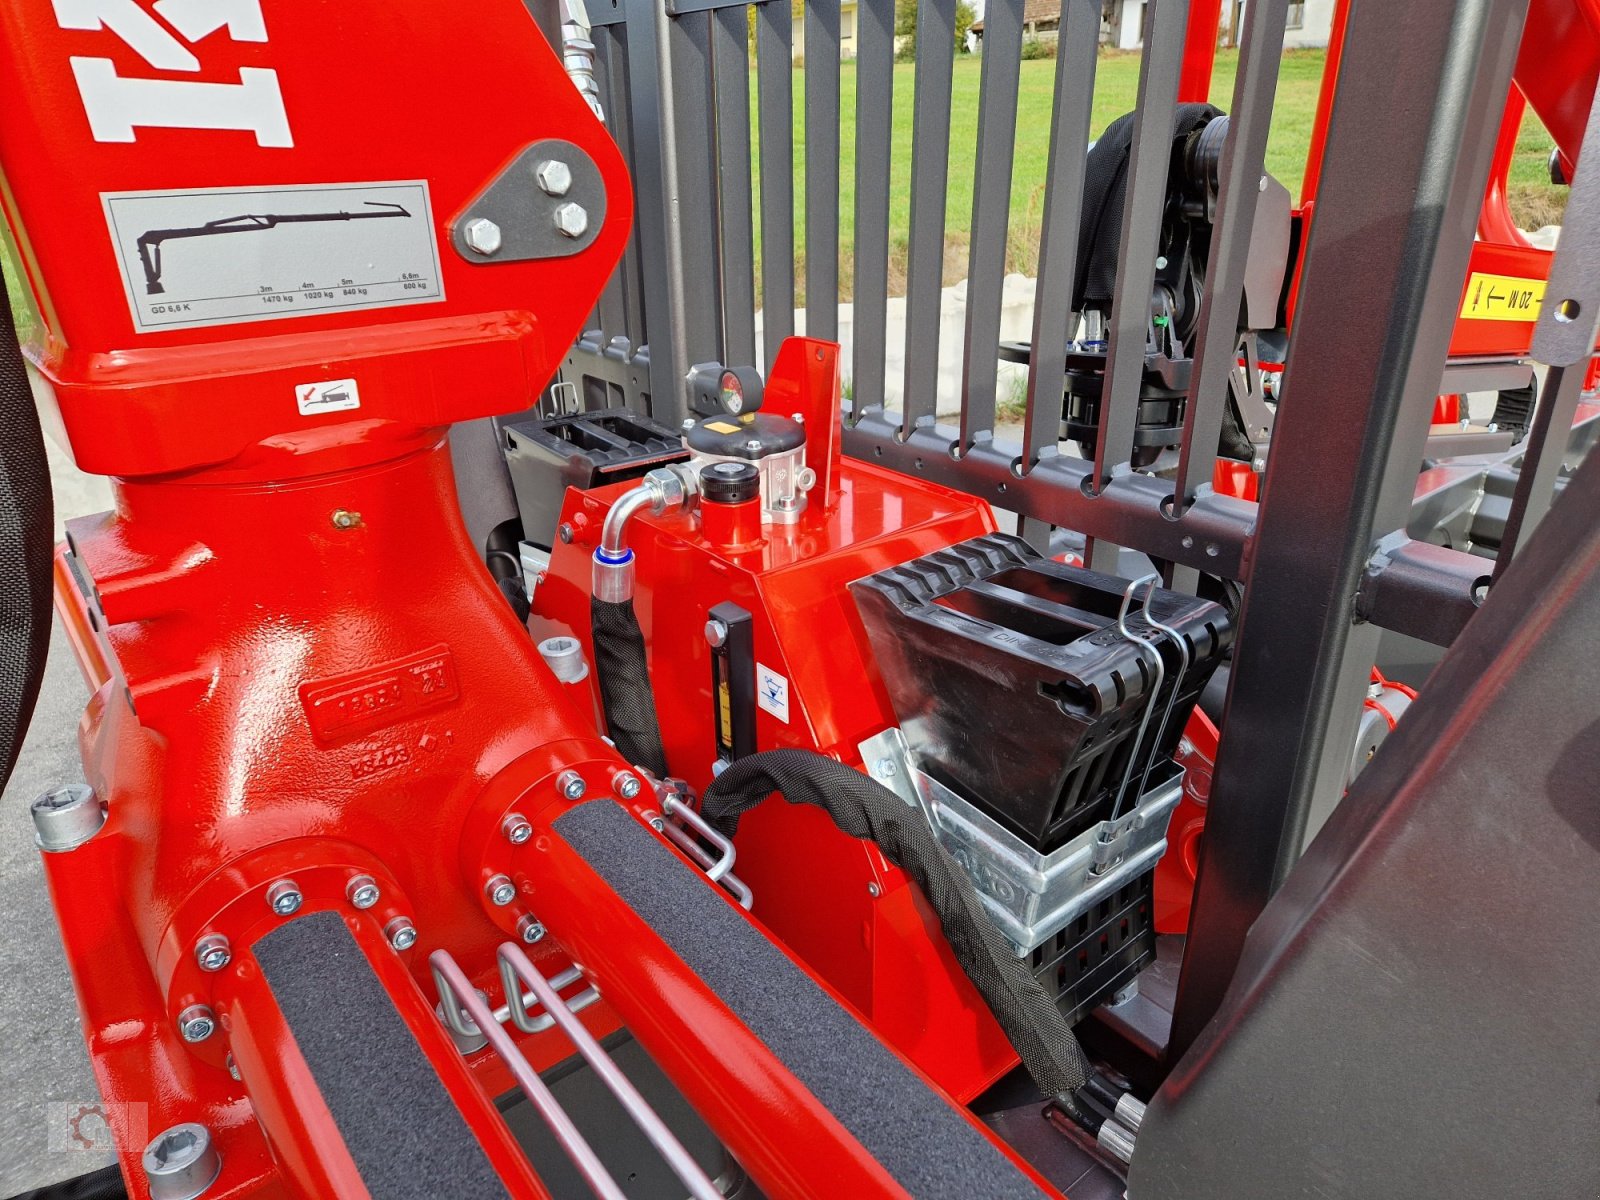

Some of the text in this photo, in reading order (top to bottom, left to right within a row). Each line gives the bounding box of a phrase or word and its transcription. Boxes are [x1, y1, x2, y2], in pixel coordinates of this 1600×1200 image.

[302, 282, 315, 290] 4m
[341, 278, 353, 286] 5m
[417, 281, 427, 290] kg
[259, 285, 273, 293] 3m
[357, 287, 368, 295] kg
[262, 294, 294, 304] 1470 kg
[304, 290, 334, 300] 1020 kg
[1508, 290, 1533, 309] 20 M
[151, 303, 191, 314] GD 6,6 K
